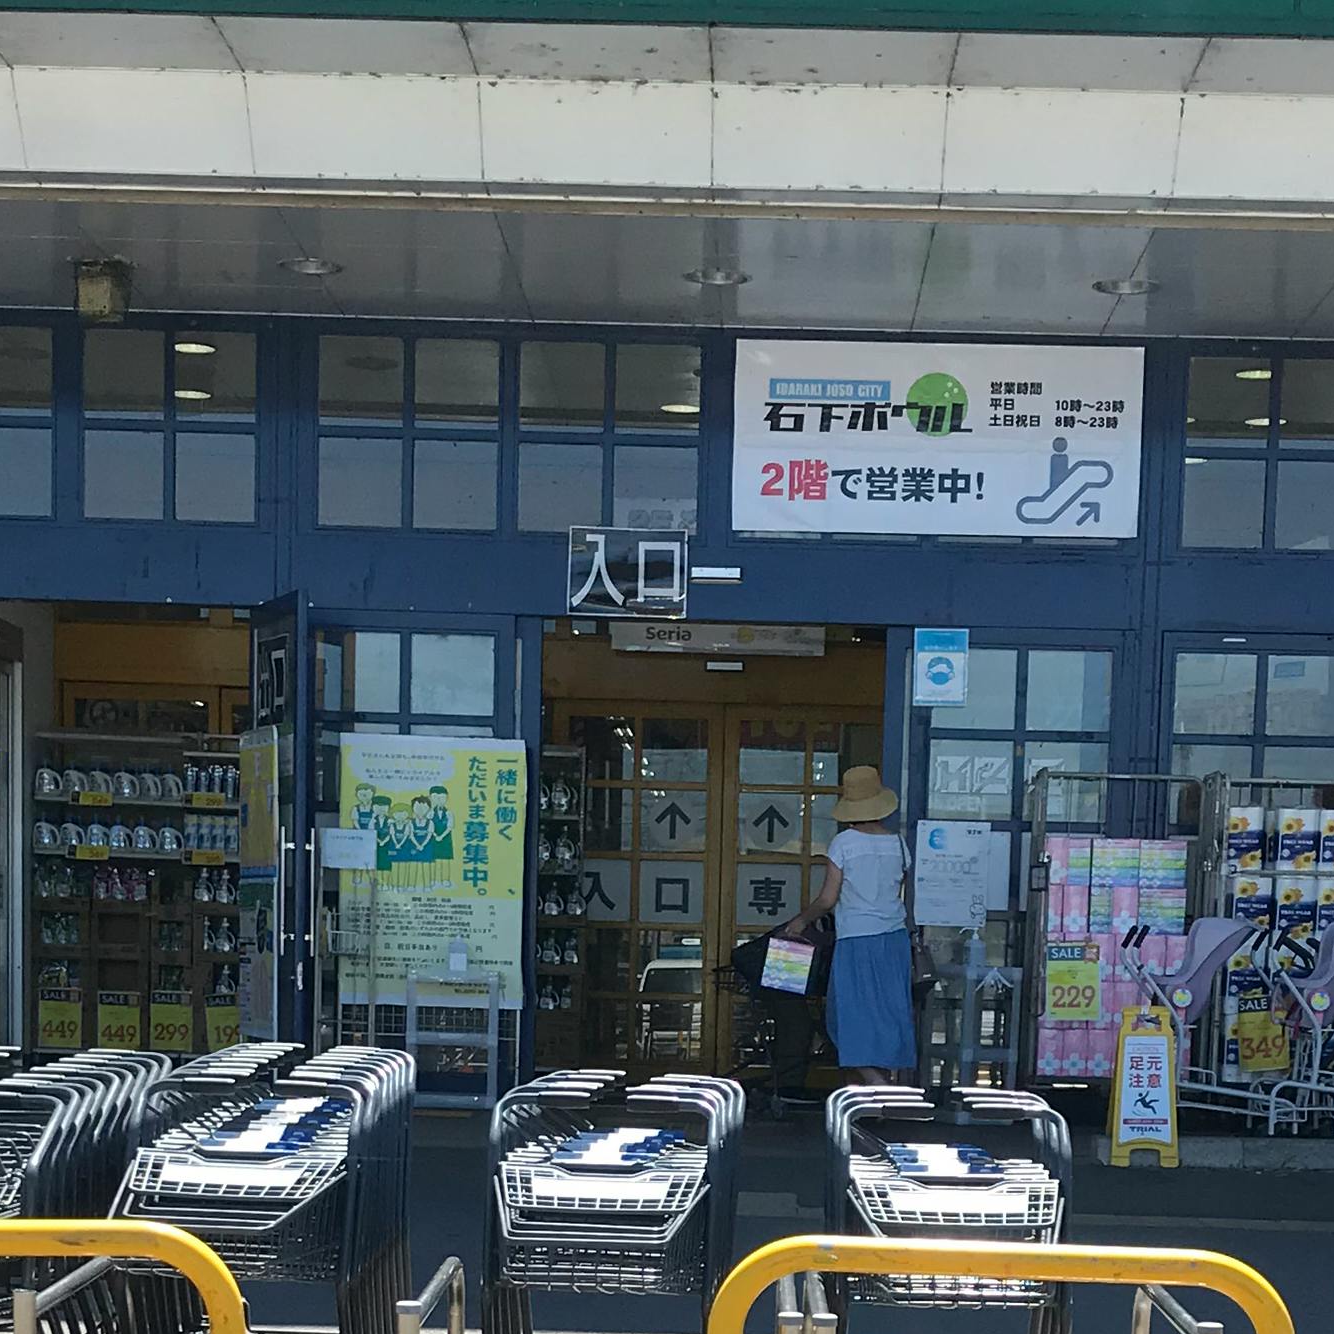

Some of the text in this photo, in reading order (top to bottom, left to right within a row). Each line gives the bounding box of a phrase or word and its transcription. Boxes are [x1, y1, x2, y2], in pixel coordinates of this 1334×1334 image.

[825, 384, 854, 397] JOSO
[857, 385, 884, 398] CITY
[990, 381, 1043, 395] 営業時間
[989, 398, 1015, 411] 平日
[988, 413, 1041, 428] 土日祝日
[570, 533, 682, 607] 入口
[645, 626, 692, 641] Seria
[1051, 947, 1082, 959] SALE
[1051, 985, 1096, 1009] 229
[1240, 999, 1268, 1011] SALE
[42, 1020, 79, 1039] 449
[100, 1024, 137, 1042] 449
[154, 1022, 189, 1042] 299
[1242, 1034, 1286, 1060] 349
[1129, 1056, 1163, 1071] 足元
[1128, 1073, 1162, 1088] 注意
